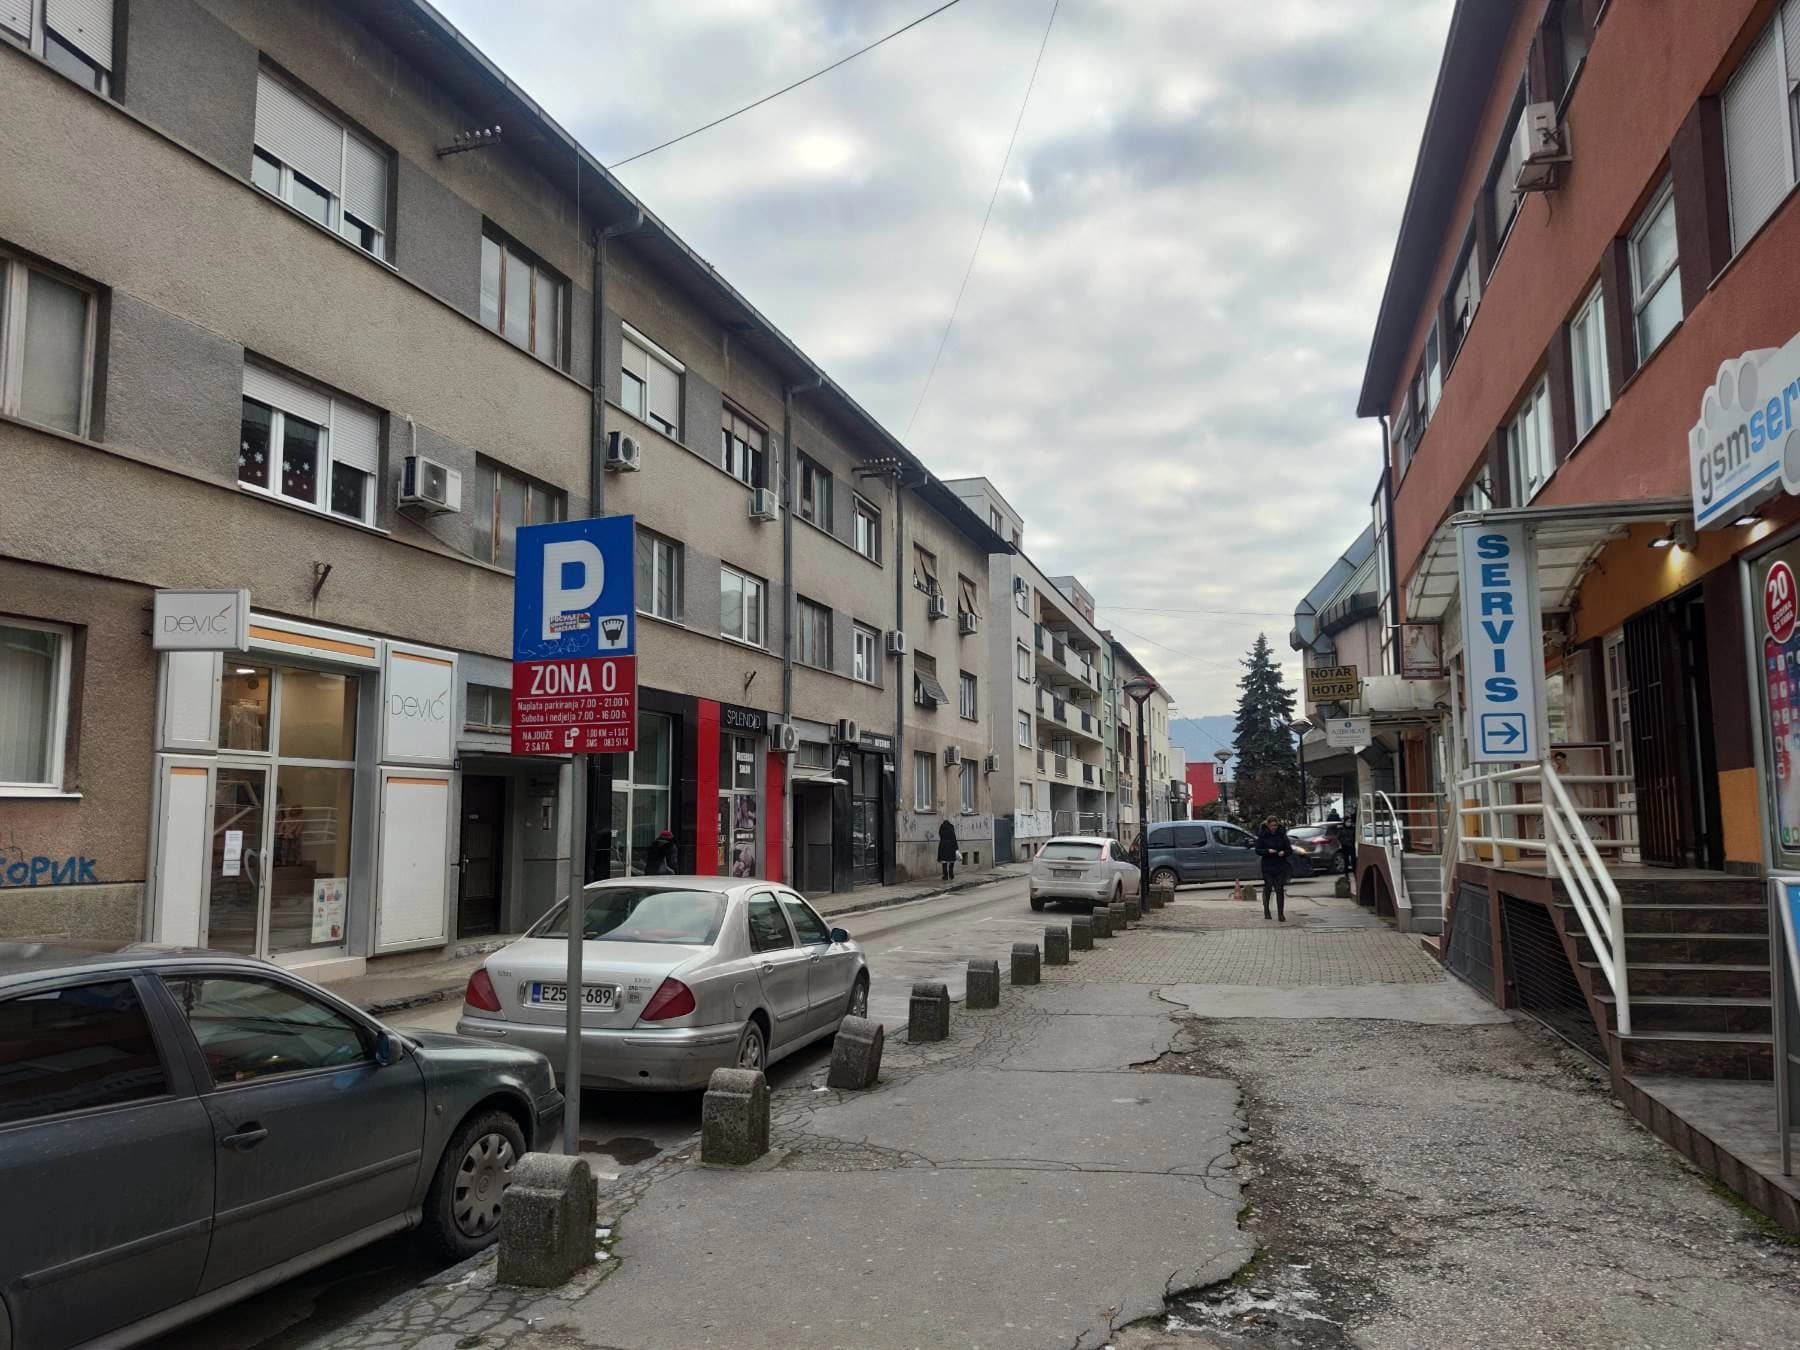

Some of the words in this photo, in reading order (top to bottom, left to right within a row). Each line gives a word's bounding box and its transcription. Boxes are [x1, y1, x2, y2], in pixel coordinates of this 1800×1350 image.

[1699, 377, 1800, 505] gsmser
[542, 540, 604, 640] P
[1769, 571, 1788, 610] 20
[1476, 534, 1519, 702] SERVIS
[530, 663, 593, 695] ZONA
[1311, 668, 1352, 679] NOTAR
[1312, 684, 1354, 695] НОТАР
[518, 701, 543, 712] Naplata
[544, 700, 579, 712] parkiranja
[580, 698, 597, 708] 7.00
[604, 697, 623, 707] 21.00
[521, 713, 545, 723] Subota
[550, 712, 577, 723] nedjelja
[578, 711, 594, 720] 7.00
[727, 709, 761, 729] SPLENDID
[522, 729, 554, 740] NAJDUŽE
[525, 742, 530, 752] 2
[531, 741, 550, 752] SATA
